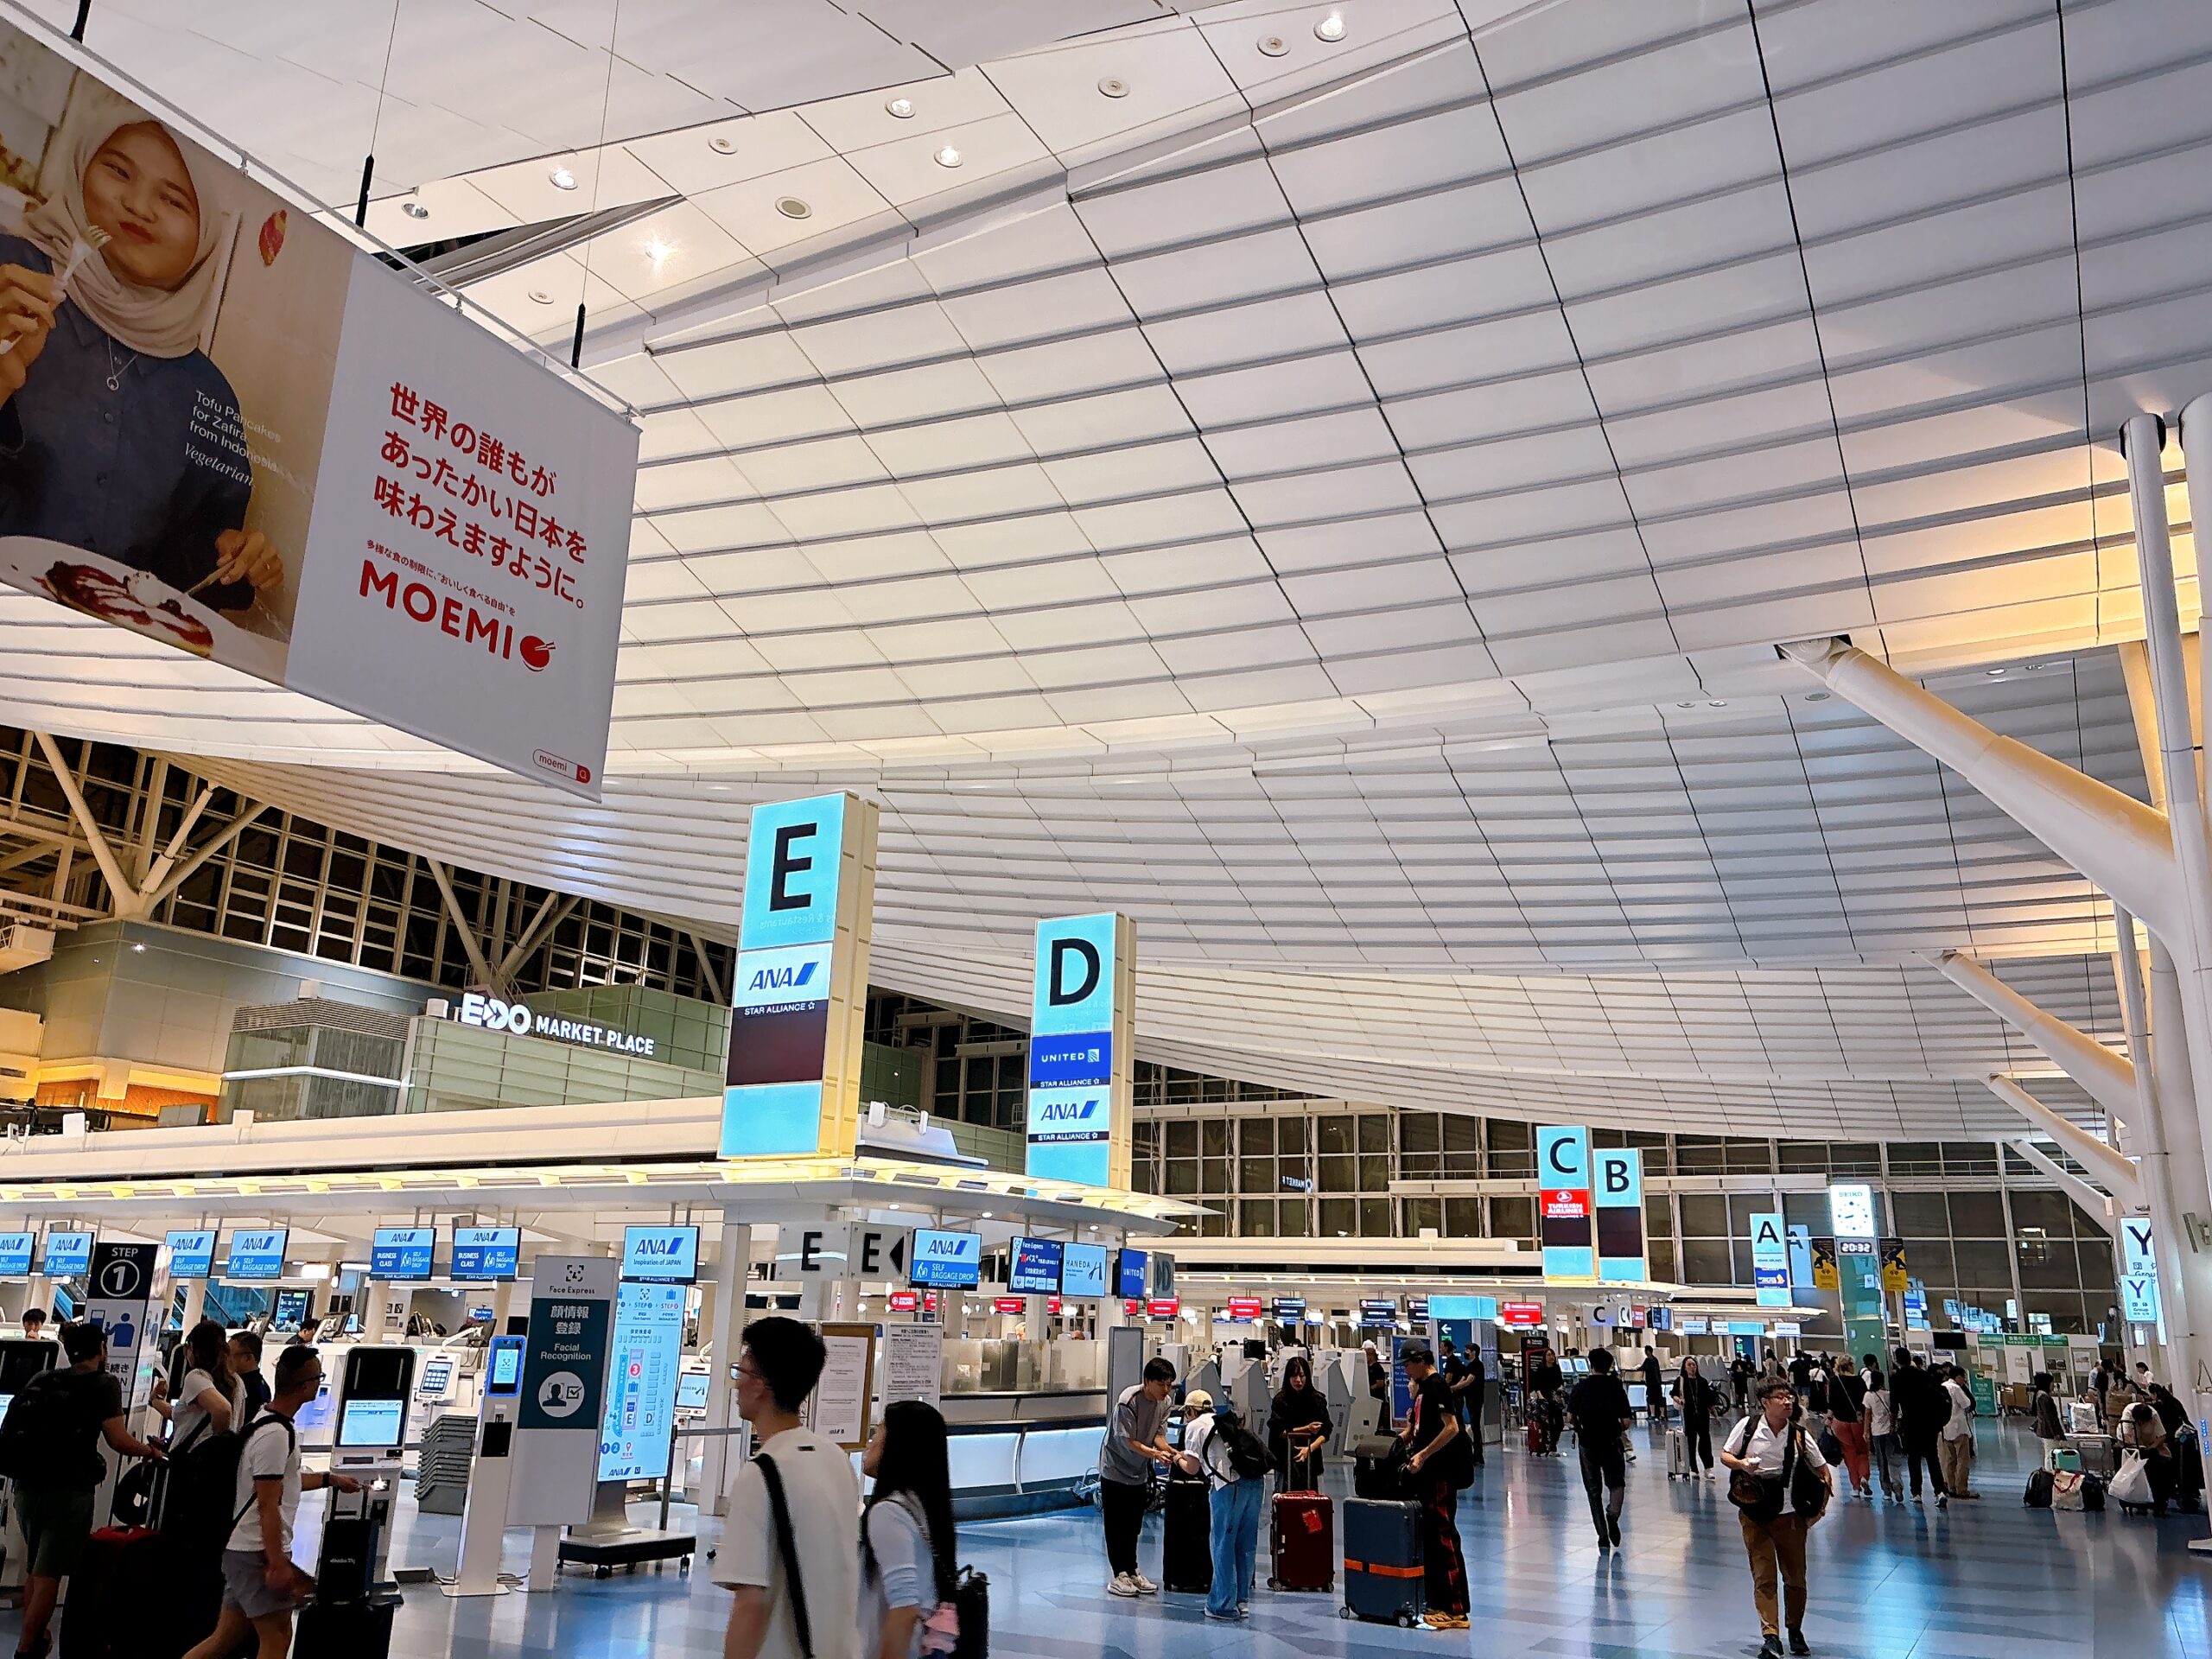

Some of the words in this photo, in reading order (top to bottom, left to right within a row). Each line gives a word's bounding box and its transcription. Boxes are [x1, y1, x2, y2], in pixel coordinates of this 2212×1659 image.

[193, 405, 210, 423] for
[213, 416, 247, 442] Zafira
[195, 389, 222, 413] Tofu
[225, 405, 282, 443] Pancakes
[189, 420, 218, 443] from
[390, 381, 557, 497] 世界の誰もが
[380, 429, 588, 564] あったかい日本を
[373, 475, 585, 610] 味わえますように。
[359, 559, 514, 660] MOEMI
[539, 754, 567, 772] moemi
[770, 822, 817, 912] E
[748, 967, 793, 991] ANA
[1049, 938, 1100, 1007] D
[744, 1006, 765, 1016] STAR
[766, 1002, 806, 1014] ALLIANCE
[461, 992, 531, 1035] EDO
[536, 1014, 602, 1045] MARKET
[607, 1029, 655, 1056] PLACE
[1041, 1052, 1085, 1063] UNITED
[1040, 1103, 1077, 1122] ANA
[1057, 1132, 1090, 1141] ALLIANCE
[1549, 1137, 1578, 1173] C
[1605, 1160, 1630, 1193] B
[391, 1233, 407, 1243] ANA
[473, 1232, 490, 1242] ANA
[1757, 1221, 1780, 1243] A
[2126, 1226, 2152, 1255] Y
[55, 1239, 72, 1250] ANA
[174, 1238, 194, 1249] ANA
[242, 1237, 262, 1249] ANA
[635, 1239, 665, 1255] ANA
[801, 1231, 823, 1271] E
[928, 1239, 954, 1255] ANA
[1841, 1243, 1871, 1253] 20:32
[111, 1247, 138, 1257] STEP
[862, 1232, 881, 1273] E
[113, 1265, 125, 1290] 1
[931, 1271, 958, 1280] BAGGAGE
[1123, 1268, 1140, 1276] UNITED
[2127, 1281, 2145, 1299] Y
[550, 1305, 589, 1319] 顔情報
[1593, 1306, 1606, 1323] C
[555, 1321, 582, 1335] 登録
[554, 1343, 580, 1351] Facial
[540, 1351, 592, 1362] Recognition
[632, 1365, 639, 1374] 3
[626, 1414, 633, 1424] E
[645, 1414, 652, 1424] D
